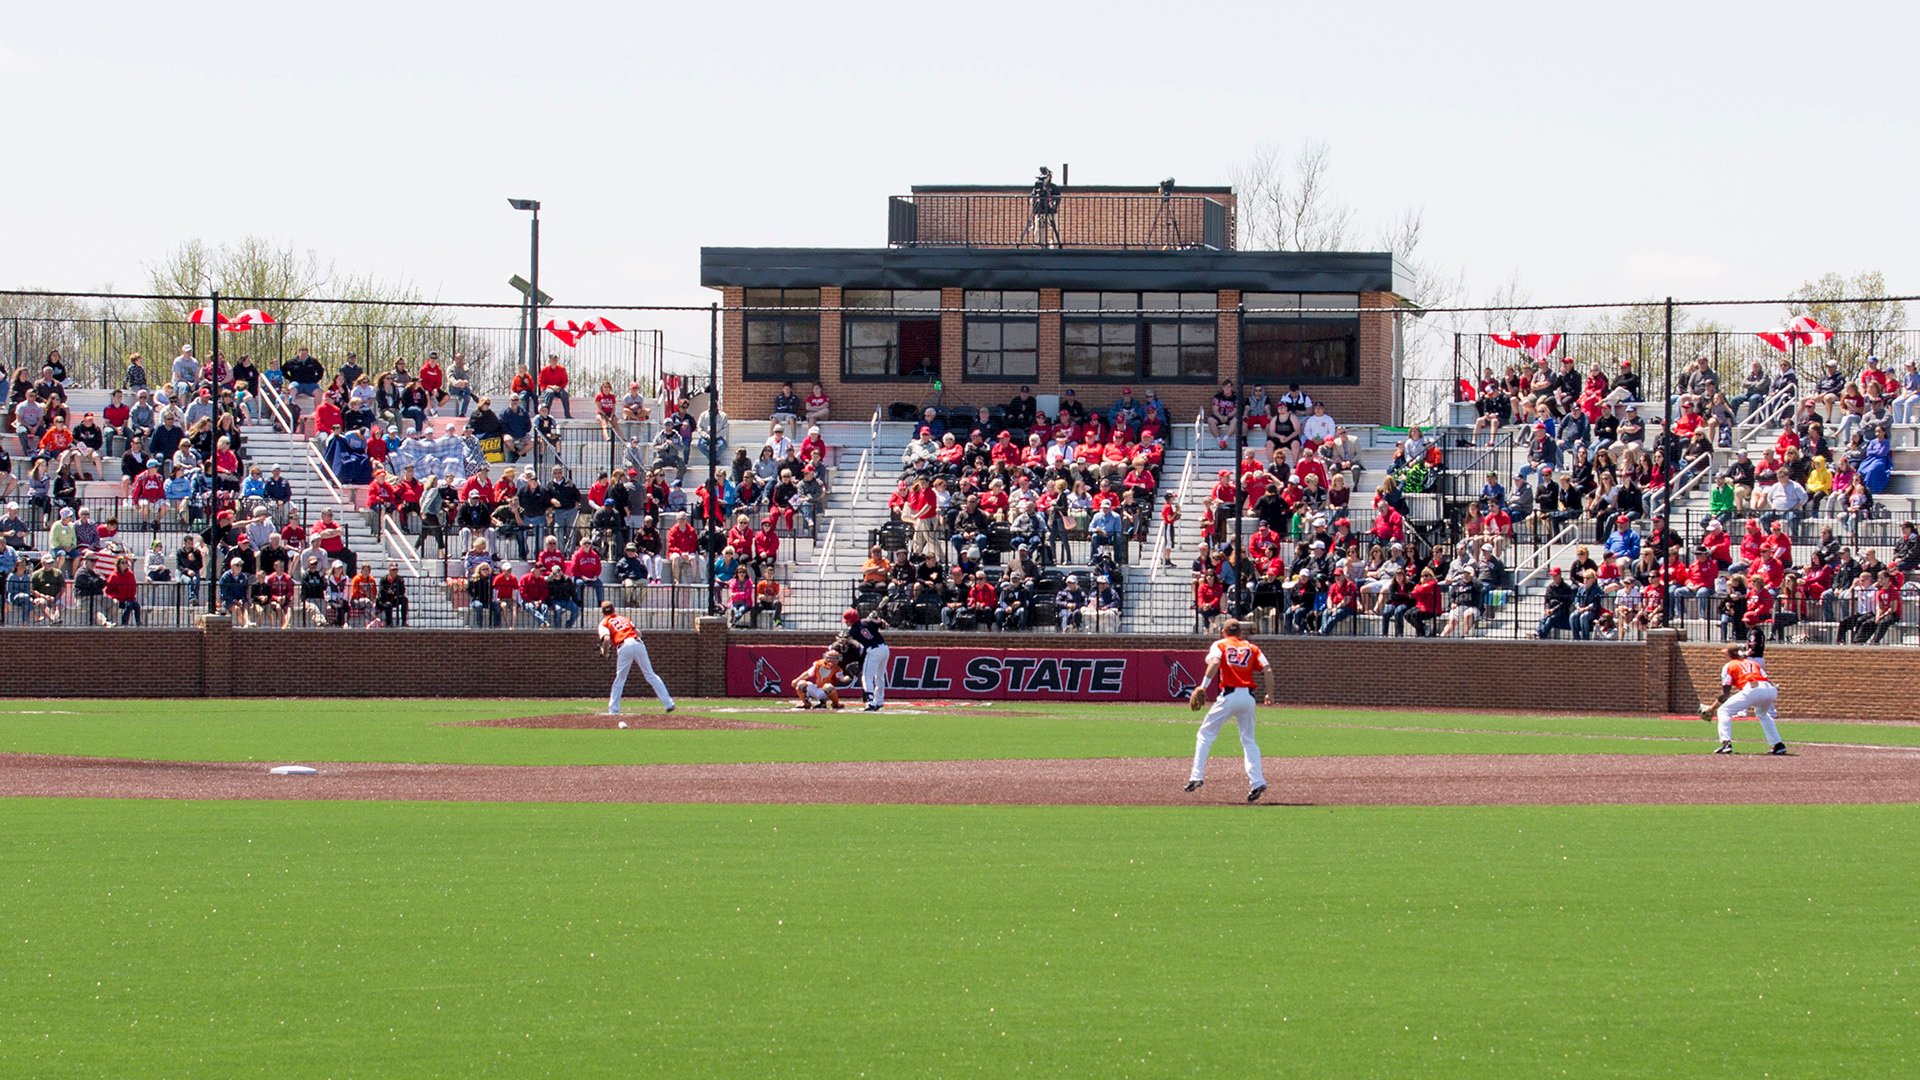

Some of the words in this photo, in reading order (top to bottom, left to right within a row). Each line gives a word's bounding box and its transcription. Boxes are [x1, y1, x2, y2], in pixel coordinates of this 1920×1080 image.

[1226, 646, 1252, 667] 27
[834, 656, 952, 690] LL
[963, 656, 1127, 693] STATE
